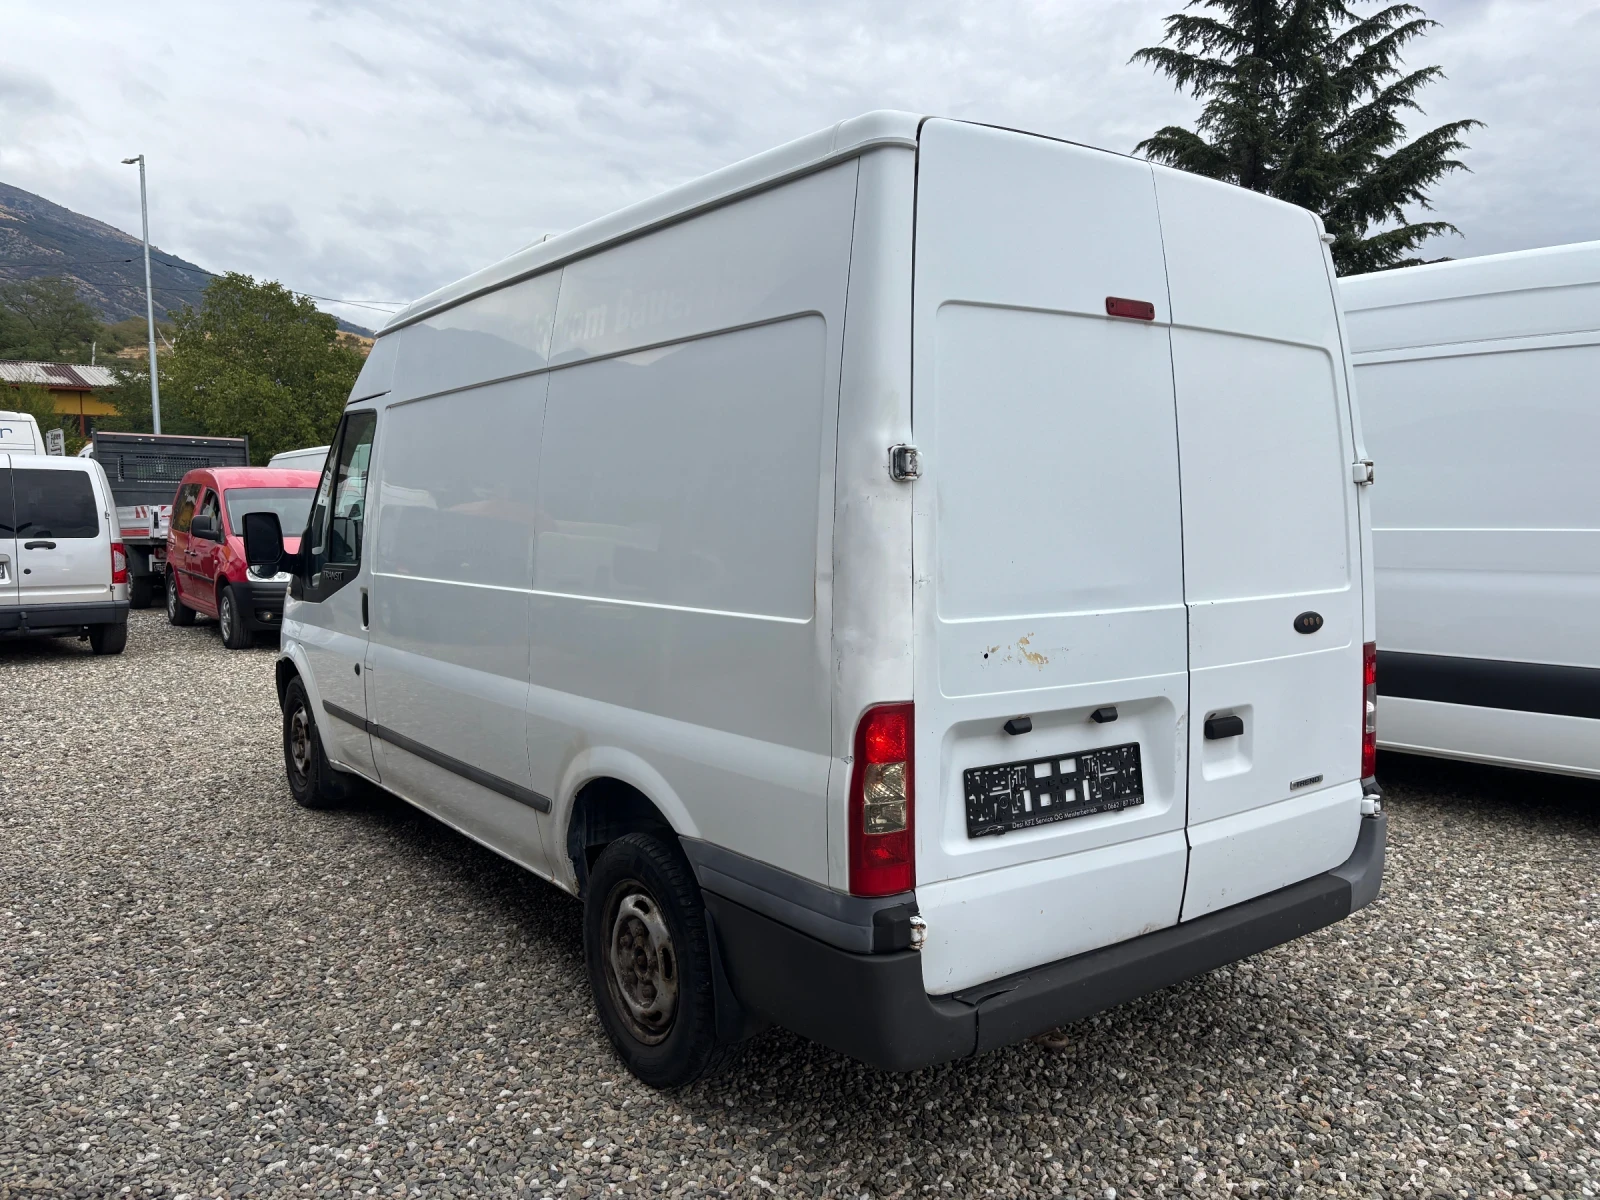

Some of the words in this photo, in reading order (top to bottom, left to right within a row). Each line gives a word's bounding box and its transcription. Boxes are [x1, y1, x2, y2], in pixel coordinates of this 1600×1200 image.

[1296, 776, 1320, 788] TREND
[1012, 820, 1024, 829] Desi
[1024, 819, 1035, 827] KFZ
[1035, 816, 1053, 825] Service
[1053, 813, 1063, 821] OG
[1064, 807, 1098, 818] Meisterbetrieb
